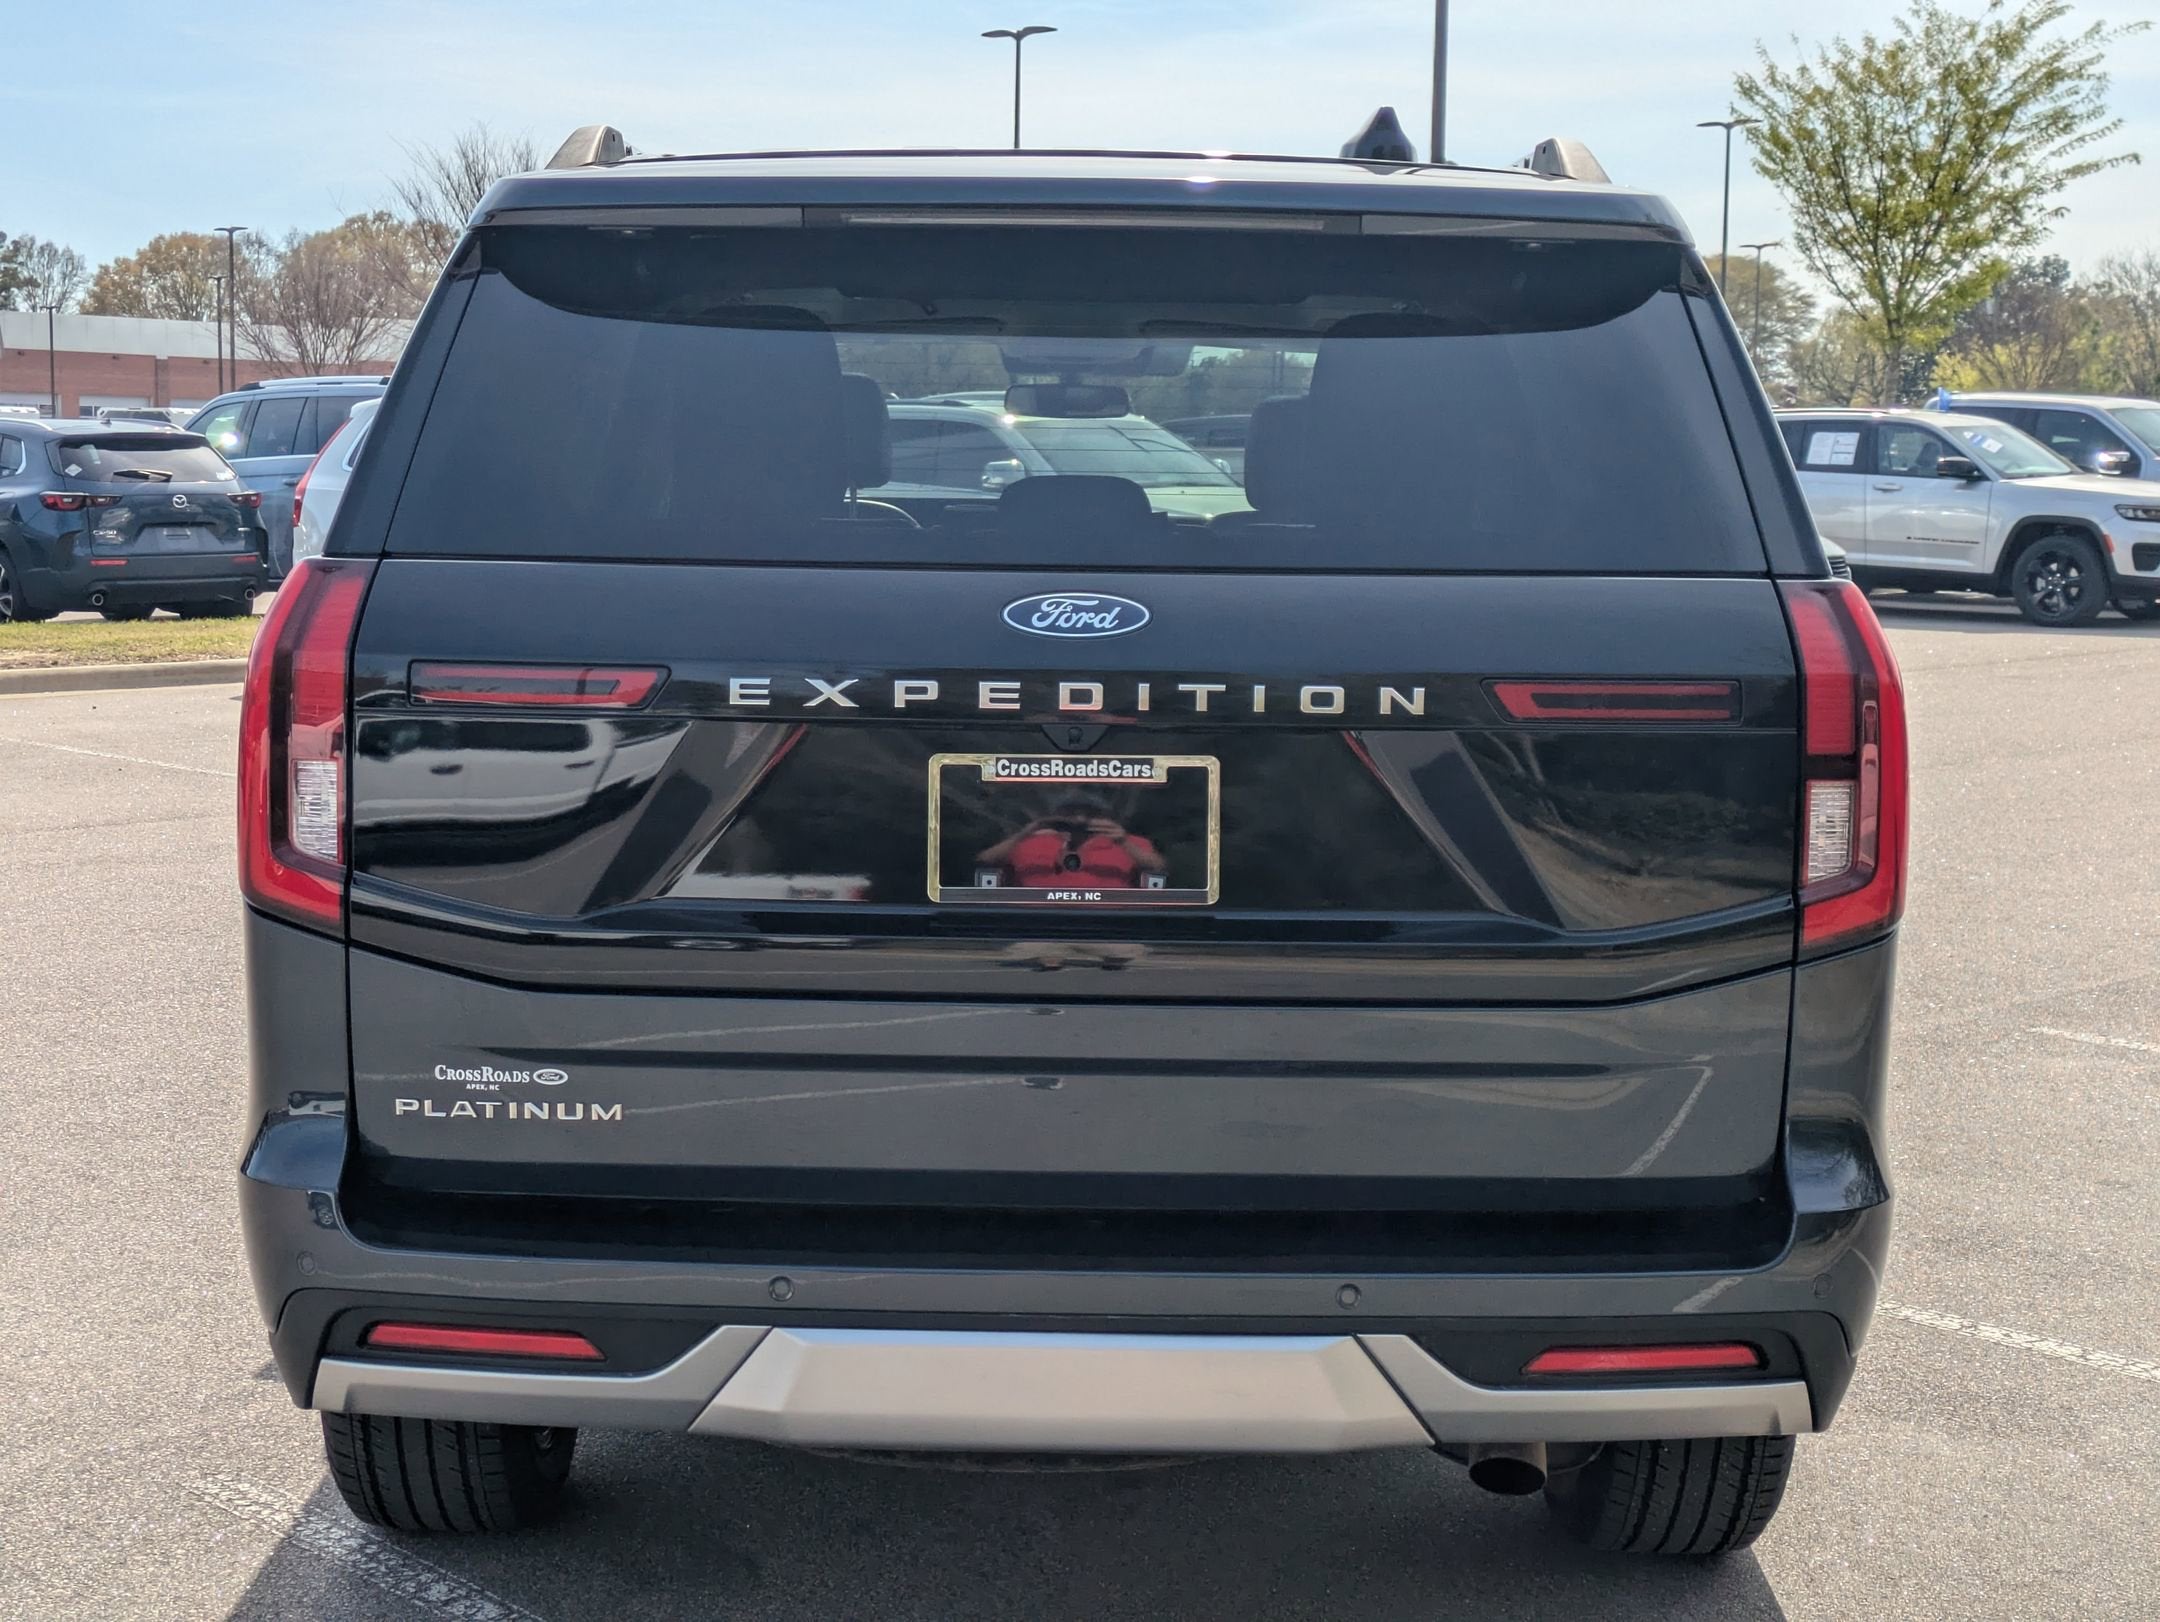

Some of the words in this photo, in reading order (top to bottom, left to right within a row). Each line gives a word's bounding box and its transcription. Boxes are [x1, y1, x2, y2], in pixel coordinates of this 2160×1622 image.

[1031, 598, 1121, 632] Ford
[728, 677, 1426, 716] EXPEDITION
[997, 759, 1152, 777] CrossRoadsCars
[1047, 891, 1082, 902] APEX,
[1085, 891, 1102, 901] NC
[466, 1083, 488, 1091] APEX,
[395, 1098, 623, 1121] PLATINUM
